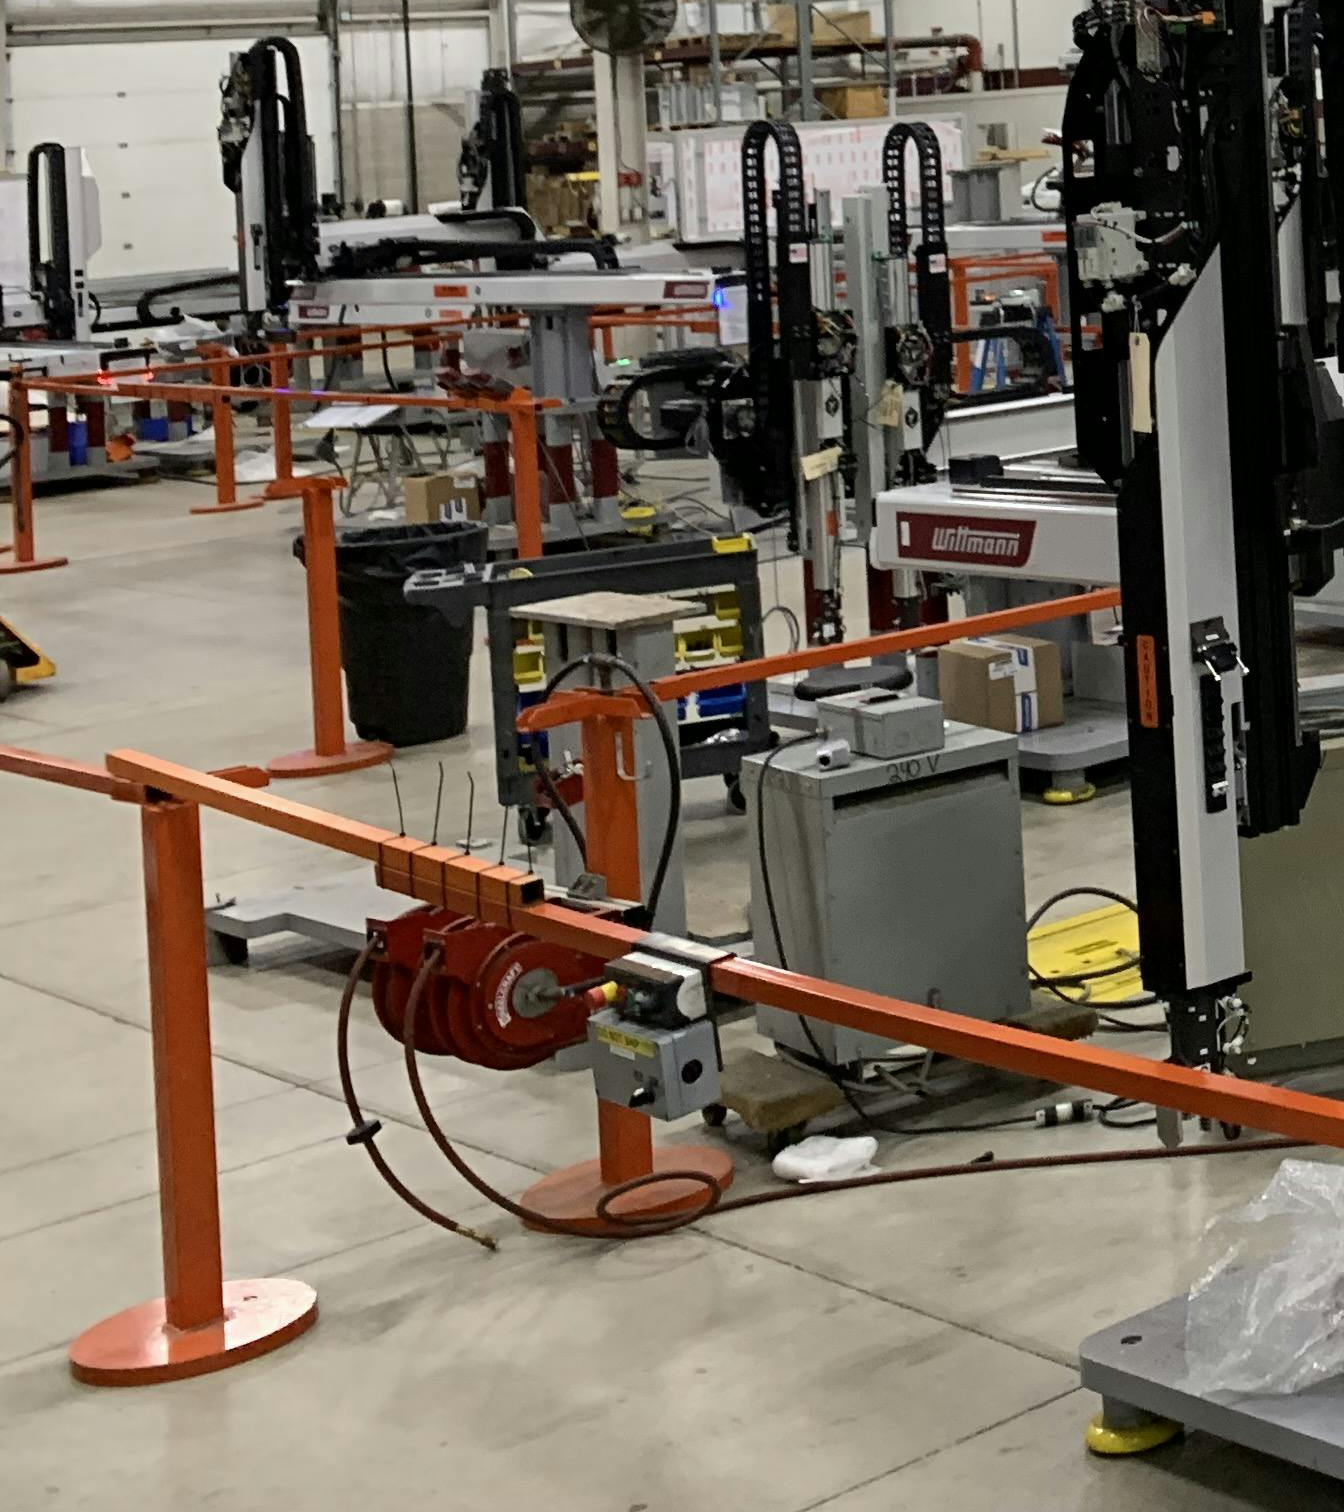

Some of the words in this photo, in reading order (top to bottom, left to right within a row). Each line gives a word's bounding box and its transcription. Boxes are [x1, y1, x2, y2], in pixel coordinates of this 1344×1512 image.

[1142, 639, 1153, 722] CAUTION
[885, 758, 921, 784] 240
[926, 753, 940, 773] V
